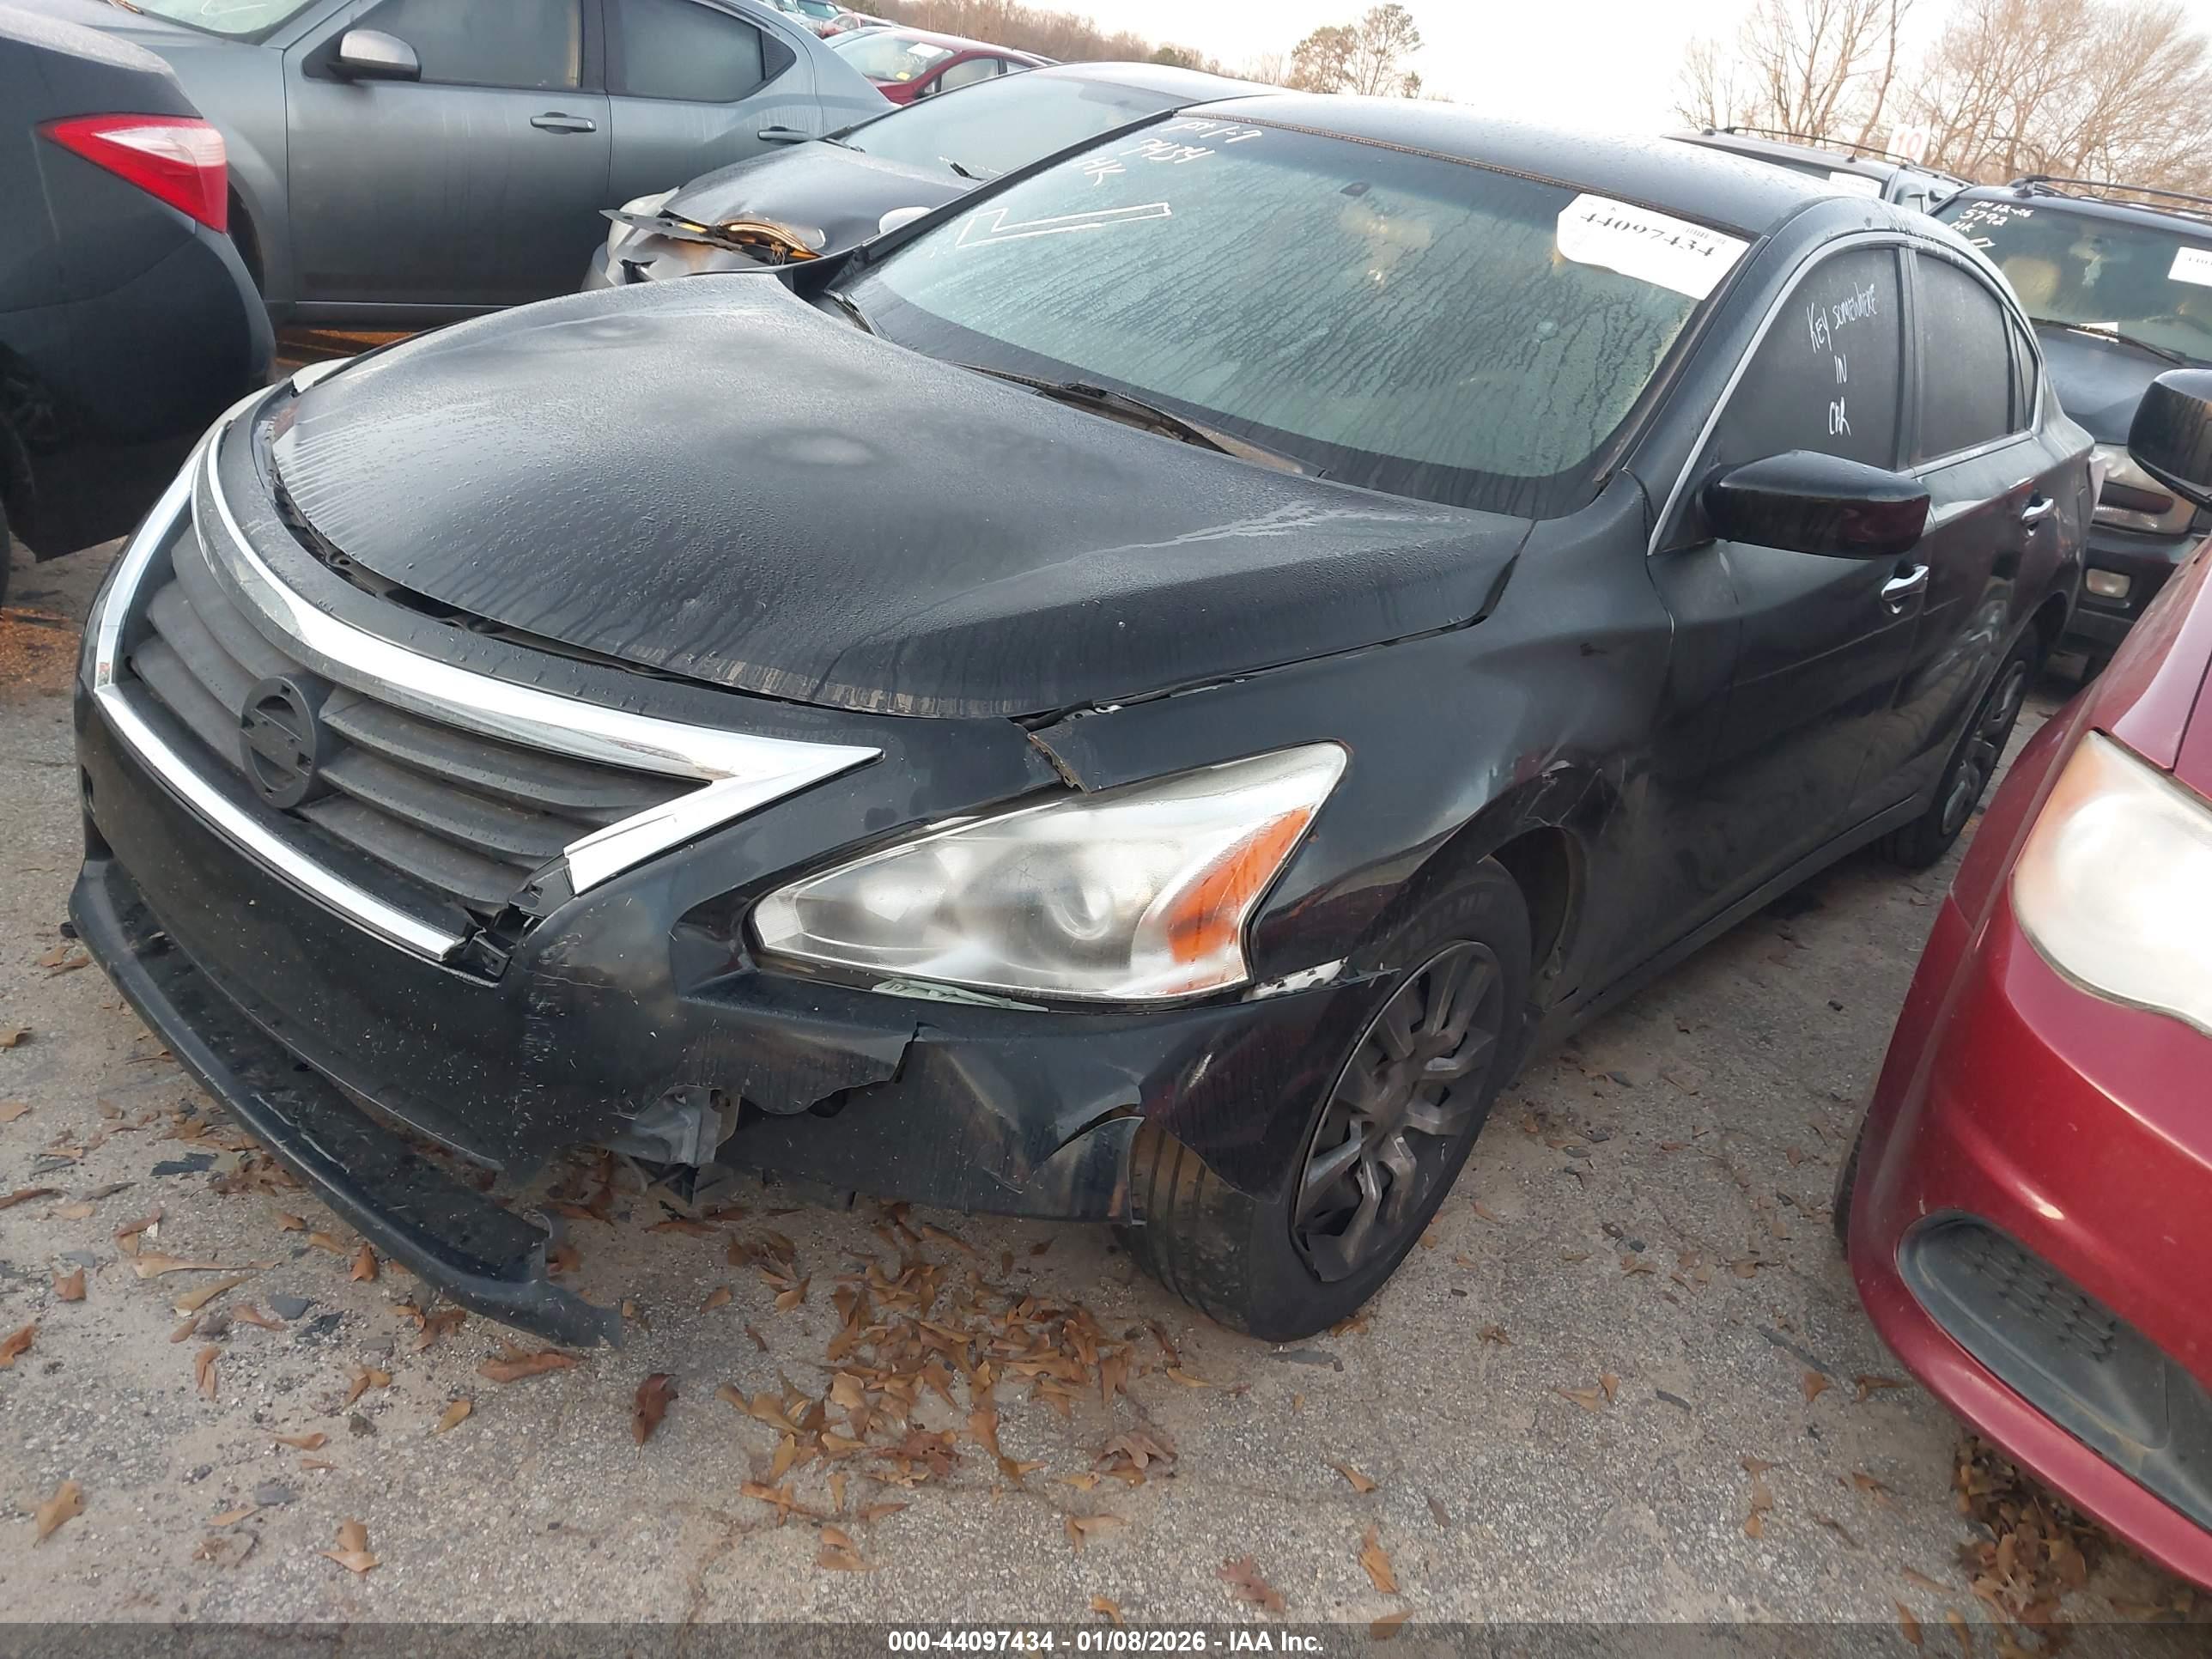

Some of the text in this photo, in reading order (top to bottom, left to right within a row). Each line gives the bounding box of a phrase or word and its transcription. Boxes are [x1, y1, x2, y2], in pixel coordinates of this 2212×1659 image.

[1895, 131, 1923, 157] 10
[1959, 209, 2008, 226] 5792
[1580, 213, 1715, 257] 44097434
[1807, 302, 1832, 354] KEY
[1834, 354, 1847, 384] IN
[1829, 397, 1851, 436] CAR
